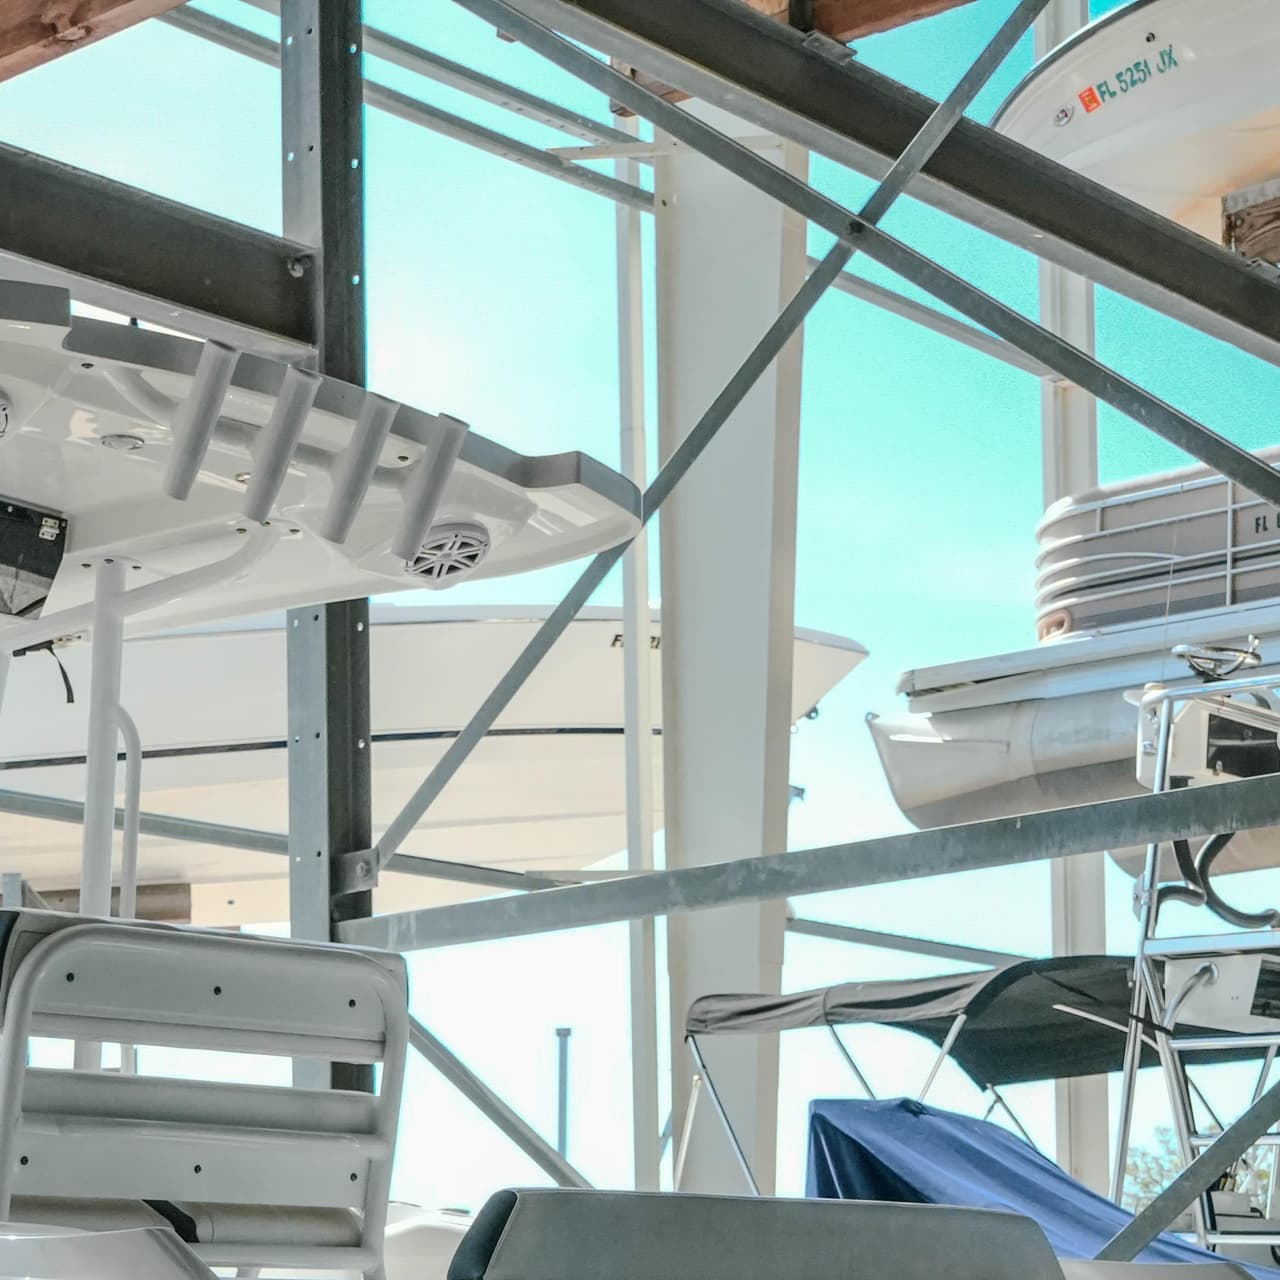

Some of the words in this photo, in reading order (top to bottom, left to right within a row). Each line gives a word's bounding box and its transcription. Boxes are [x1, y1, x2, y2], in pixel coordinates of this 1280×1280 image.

[1096, 80, 1117, 103] FL
[1115, 58, 1152, 94] 5251
[1156, 44, 1179, 73] JX
[1255, 514, 1269, 533] FL
